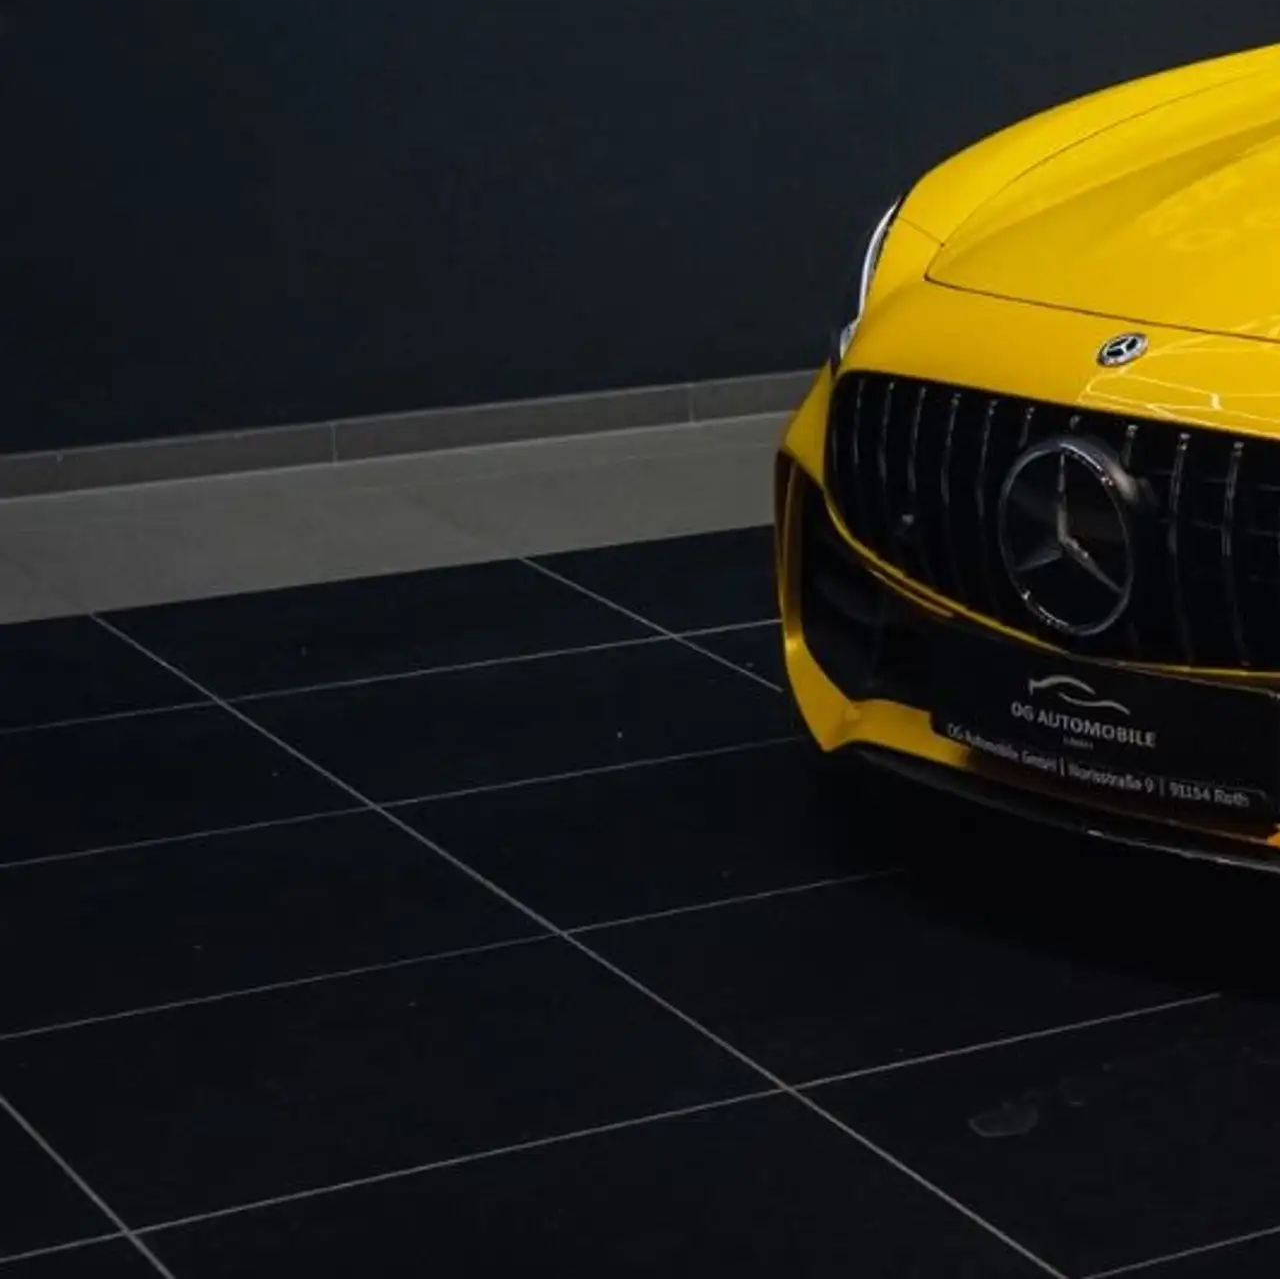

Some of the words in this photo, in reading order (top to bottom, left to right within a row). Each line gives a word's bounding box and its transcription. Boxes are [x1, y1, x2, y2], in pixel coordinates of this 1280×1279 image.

[1010, 700, 1034, 722] OG
[1037, 709, 1157, 749] AUTOMOBILE
[1214, 788, 1250, 807] Roth
